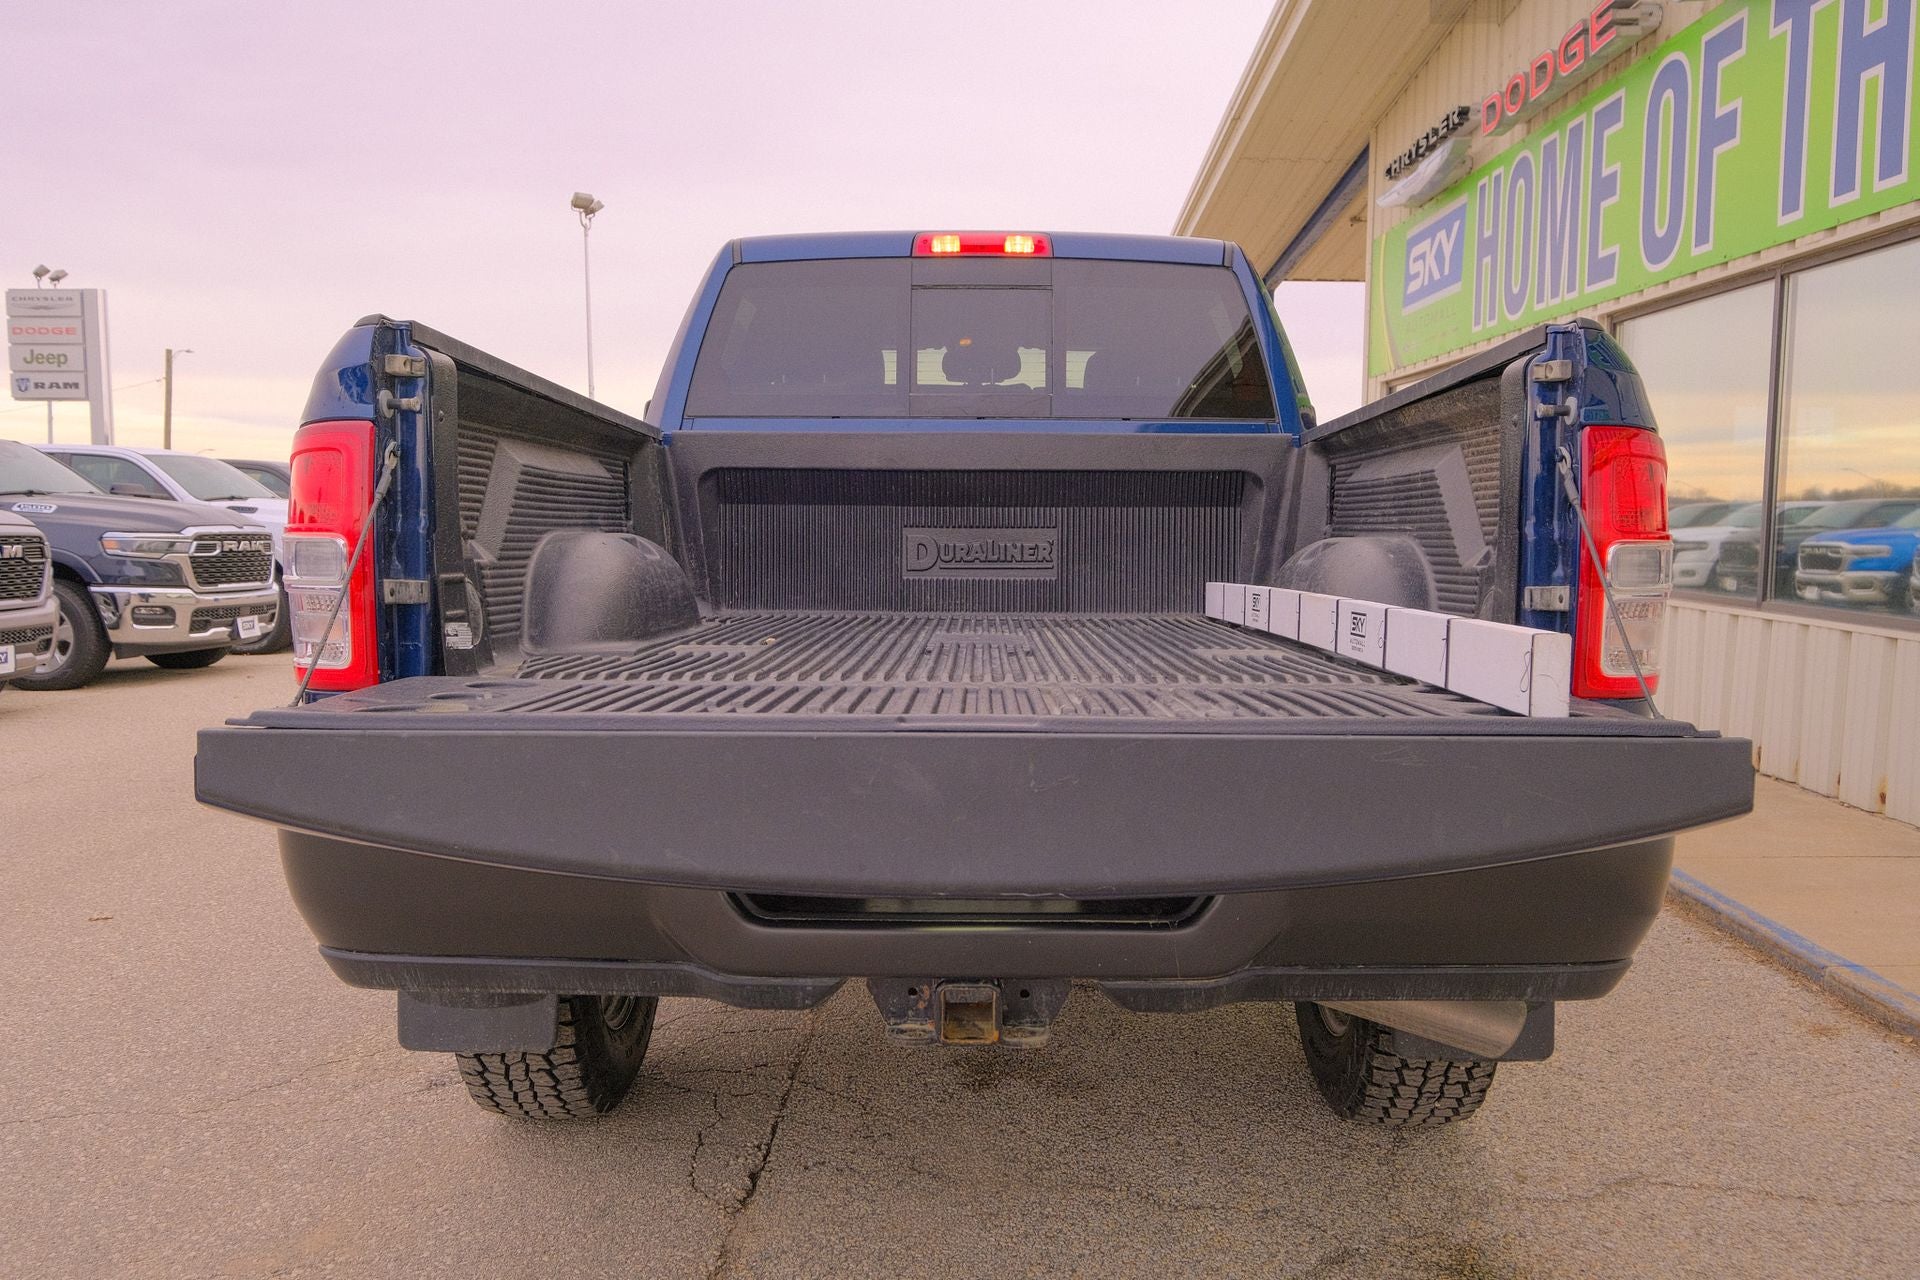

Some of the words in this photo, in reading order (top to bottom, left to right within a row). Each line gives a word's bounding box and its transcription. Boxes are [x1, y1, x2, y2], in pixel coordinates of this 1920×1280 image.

[1482, 0, 1617, 136] DODGE
[1472, 87, 1626, 333] HOME
[1640, 6, 1748, 272] OF
[1769, 0, 1918, 227] TH
[1406, 219, 1461, 295] SKY
[12, 326, 76, 335] DODGE
[23, 349, 68, 367] Jeep
[33, 382, 80, 390] RAM
[222, 540, 263, 552] RAM
[1351, 616, 1366, 633] SKY
